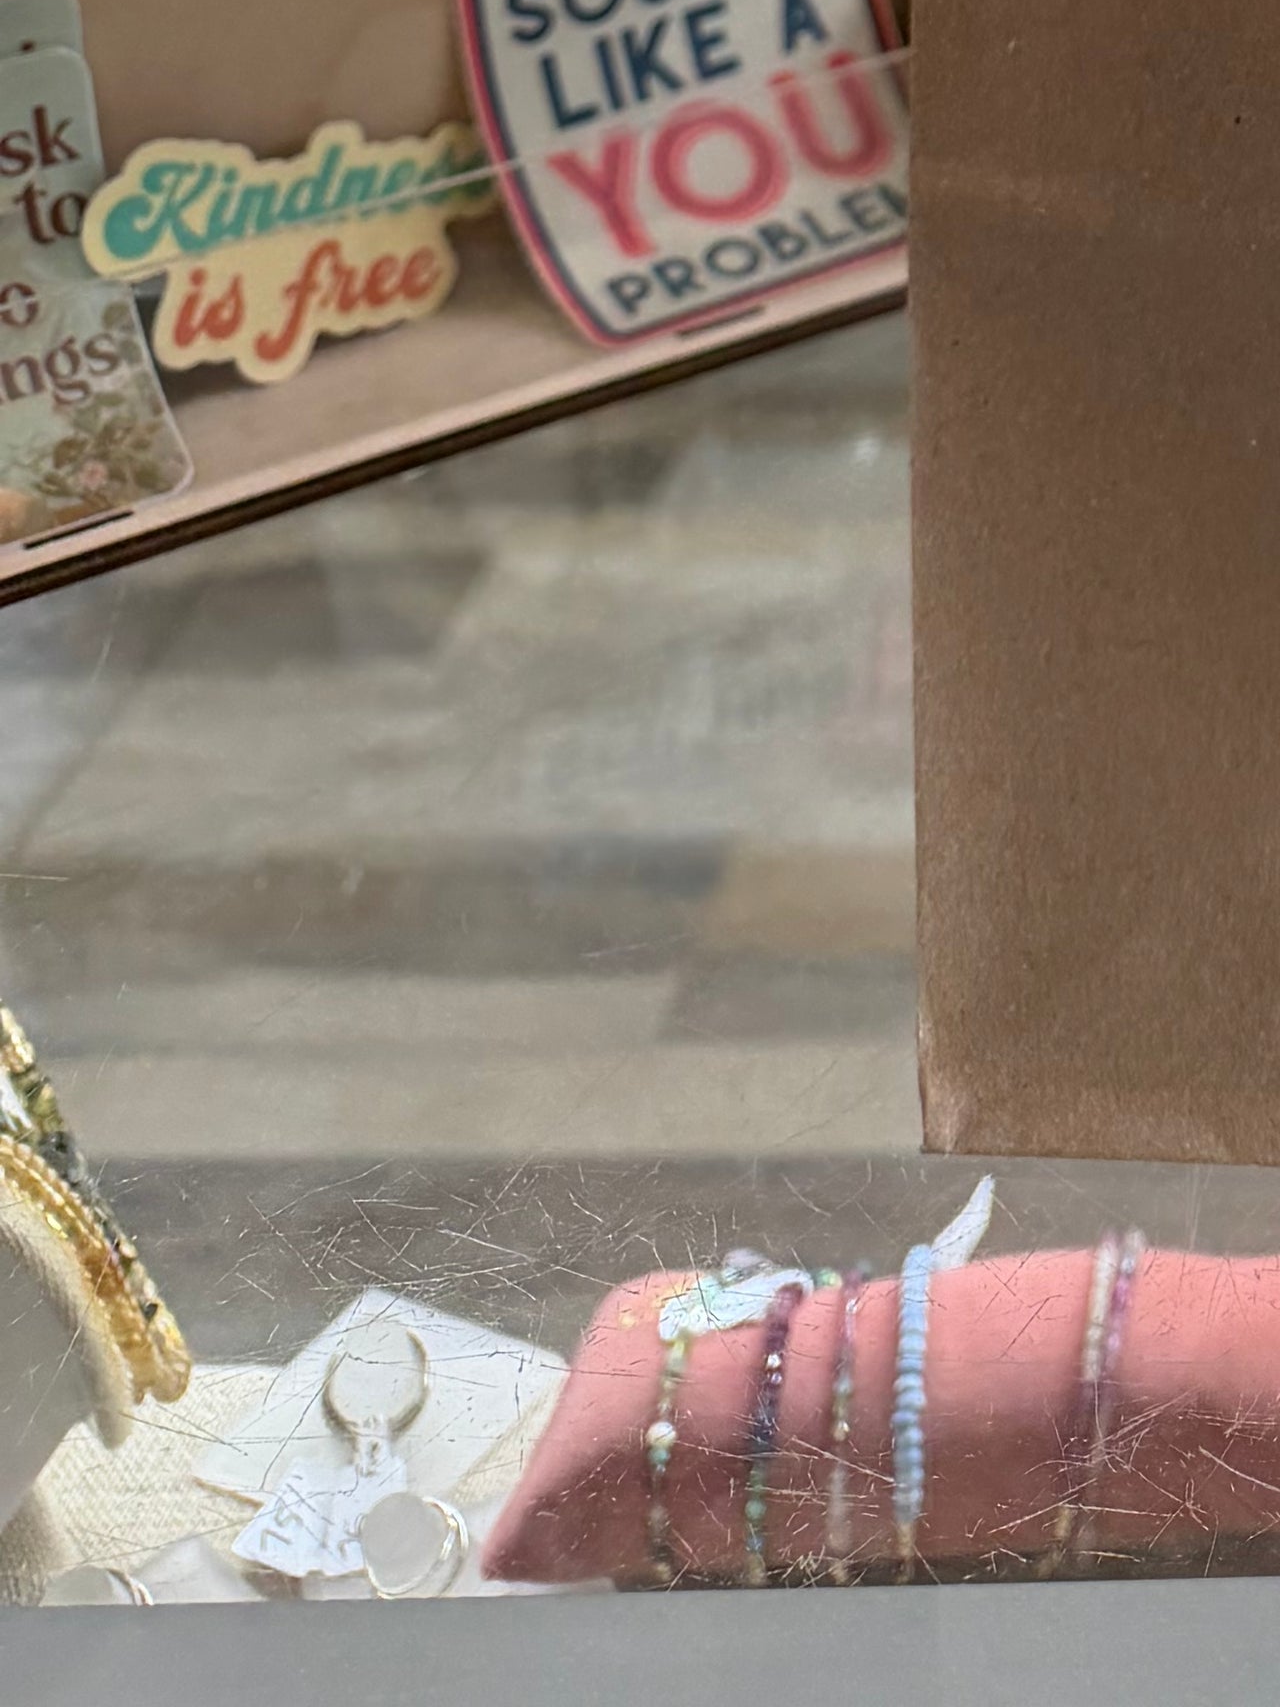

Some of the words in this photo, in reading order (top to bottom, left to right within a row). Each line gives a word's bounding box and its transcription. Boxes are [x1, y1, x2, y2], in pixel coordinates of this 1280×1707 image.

[13, 179, 88, 247] to
[543, 47, 896, 259] YOU
[171, 267, 245, 350] is
[254, 236, 444, 363] free
